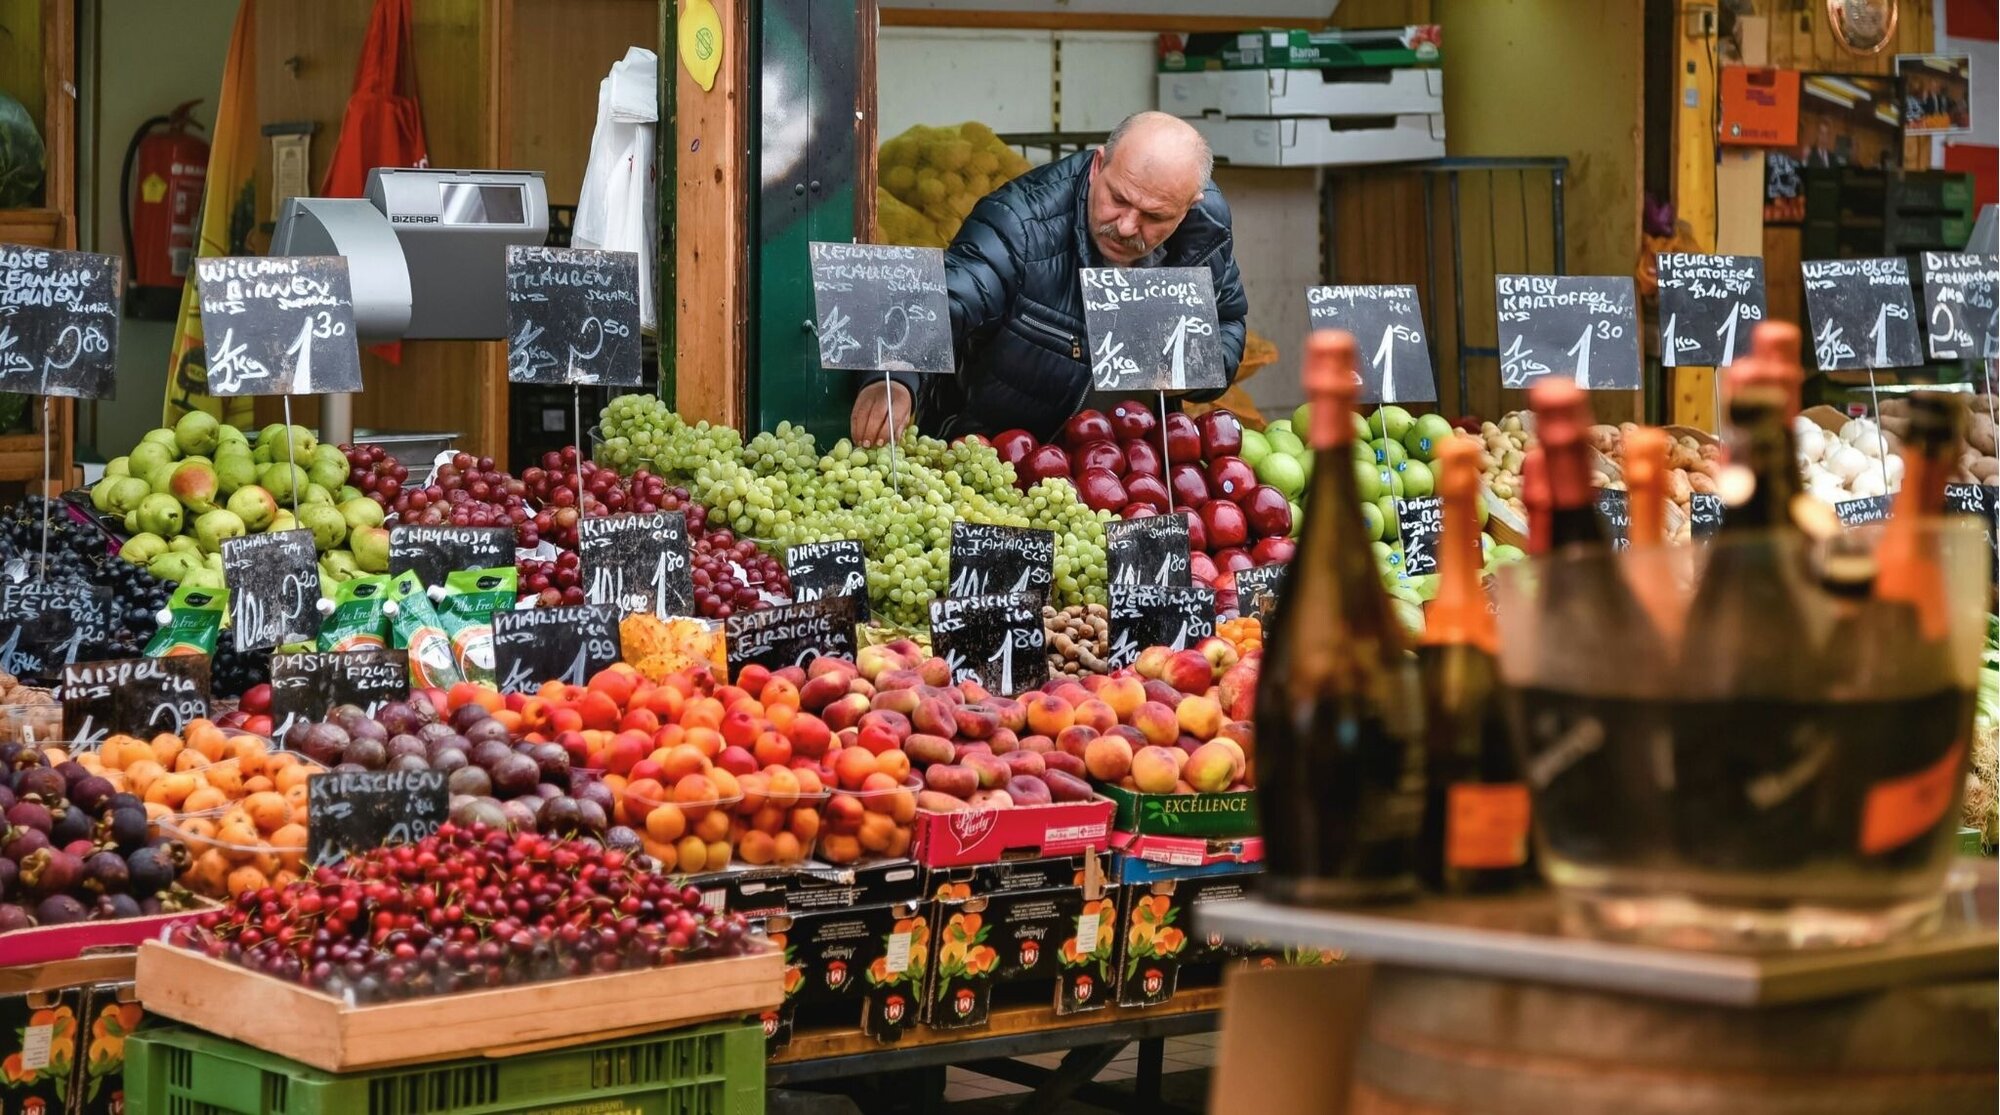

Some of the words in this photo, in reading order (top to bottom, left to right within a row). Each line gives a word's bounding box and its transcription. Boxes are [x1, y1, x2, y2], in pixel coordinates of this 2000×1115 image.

[1083, 268, 1129, 287] RED
[1499, 277, 1558, 295] BABY
[1165, 798, 1248, 813] EXCELLENCE
